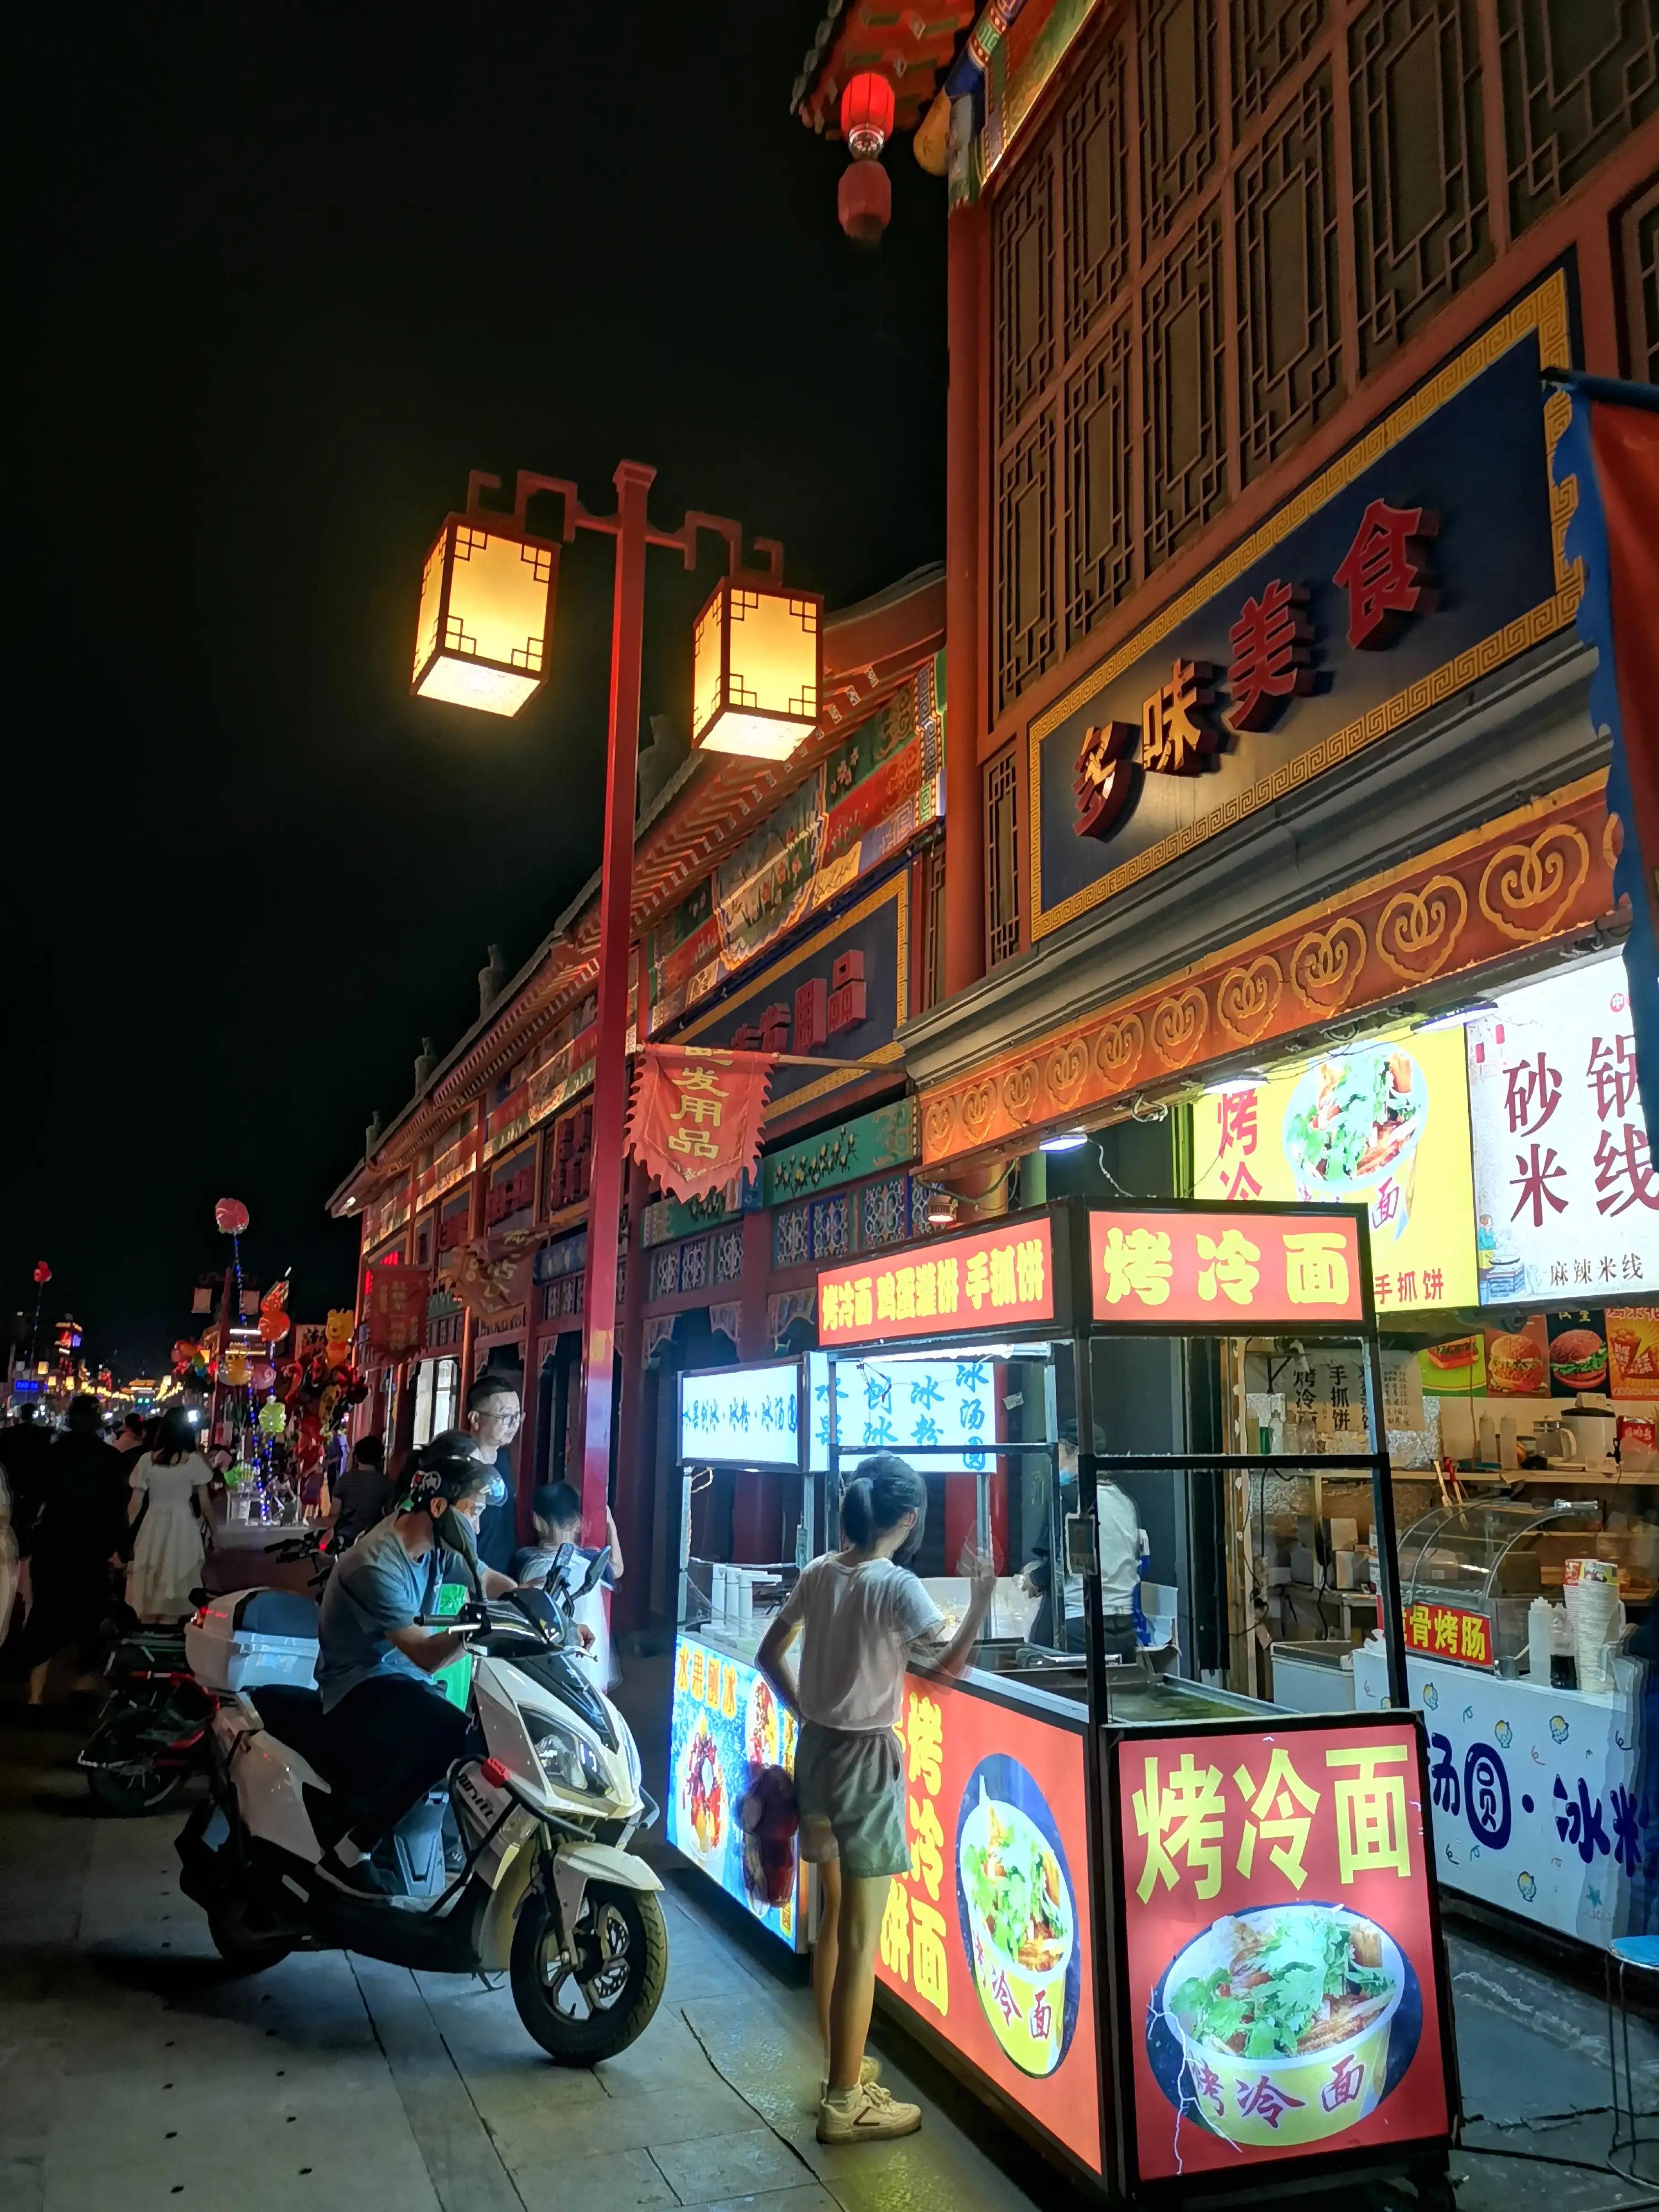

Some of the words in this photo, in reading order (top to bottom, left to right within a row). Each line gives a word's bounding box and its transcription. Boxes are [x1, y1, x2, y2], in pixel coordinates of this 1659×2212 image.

[1072, 498, 1426, 837] 多味美食
[822, 1277, 873, 1332] 烤冷面
[876, 1257, 959, 1322] 鸡蛋灌饼
[965, 1238, 1045, 1310] 手抓饼
[1103, 1227, 1350, 1306] 烤冷面
[1374, 1267, 1444, 1305] 手抓饼
[1550, 1253, 1644, 1287] 麻辣米线
[1329, 1364, 1350, 1431] 手抓饼
[1402, 1605, 1485, 1661] 骨烤肠
[908, 1692, 948, 2016] 烤冷面
[1132, 1744, 1412, 1905] 烤冷面
[1189, 2054, 1365, 2128] 烤冷面
